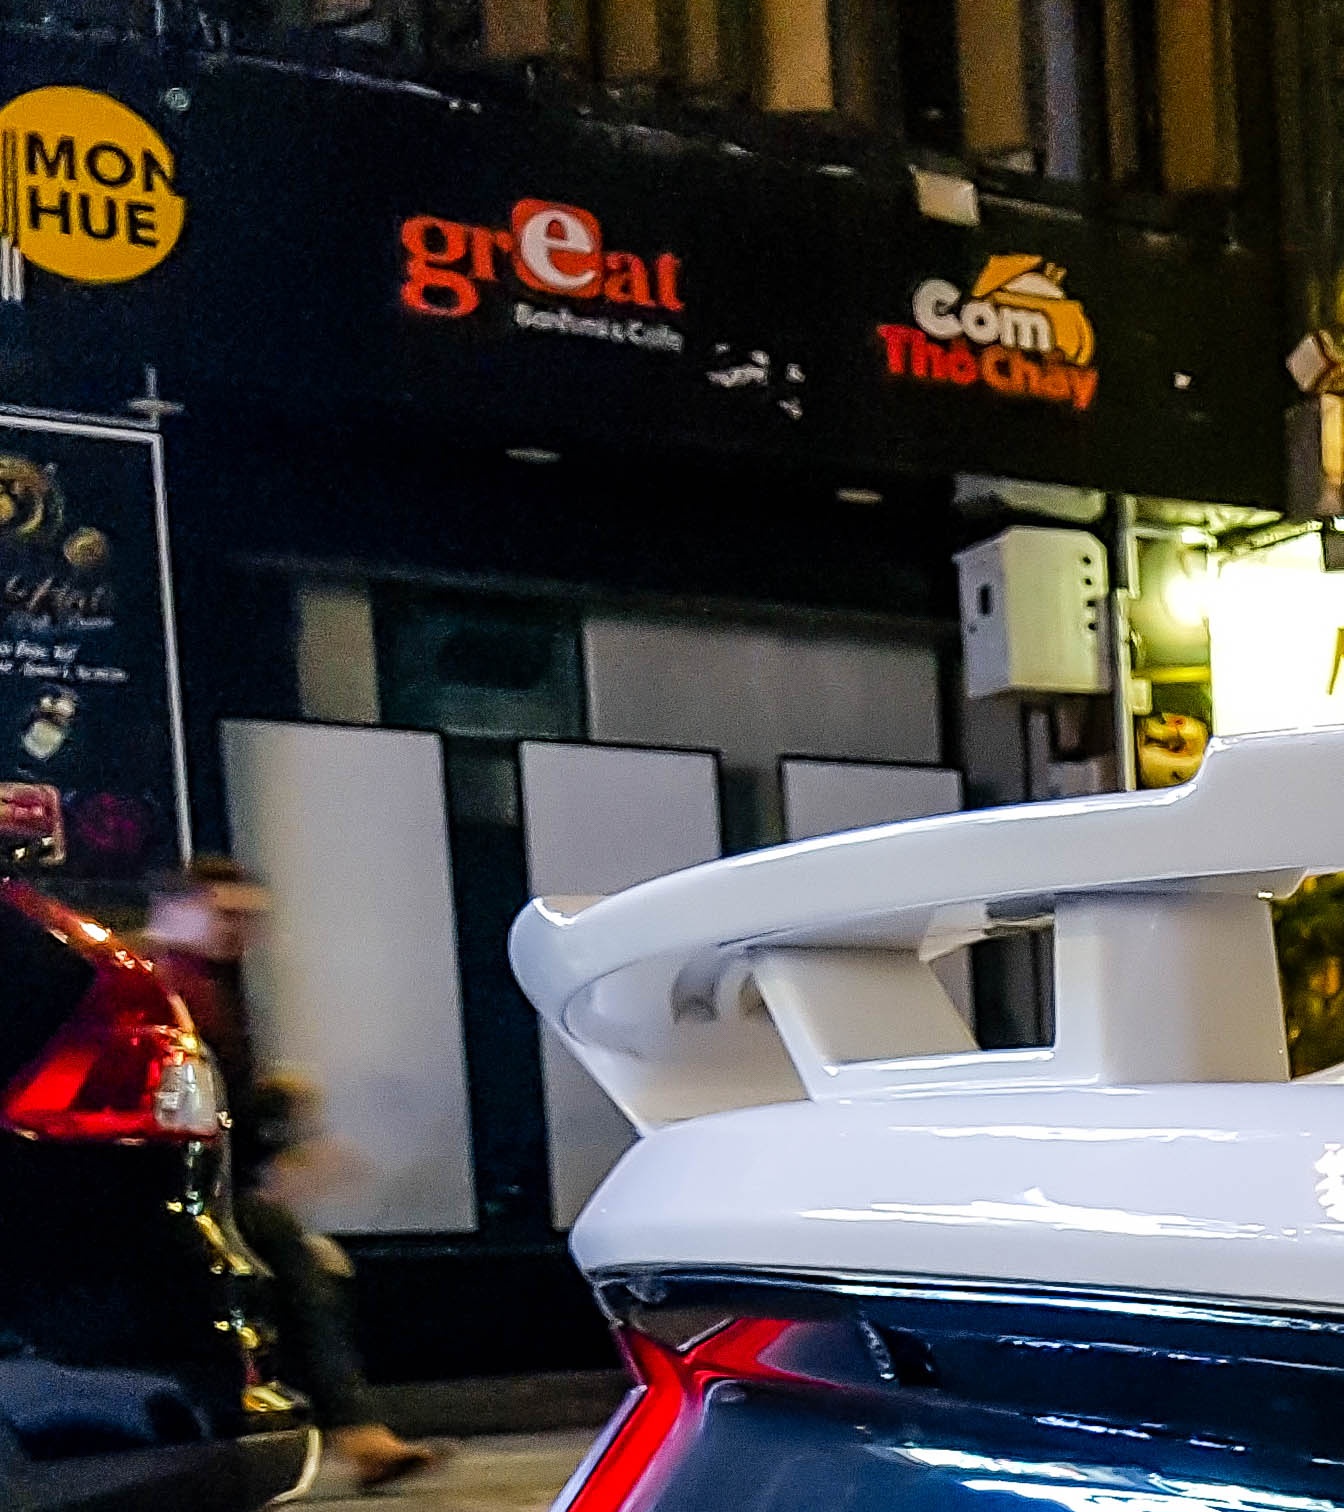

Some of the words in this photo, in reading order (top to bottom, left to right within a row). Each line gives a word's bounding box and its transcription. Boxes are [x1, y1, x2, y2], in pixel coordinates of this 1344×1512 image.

[25, 130, 179, 196] MON
[26, 185, 161, 249] HUE
[401, 205, 684, 317] great
